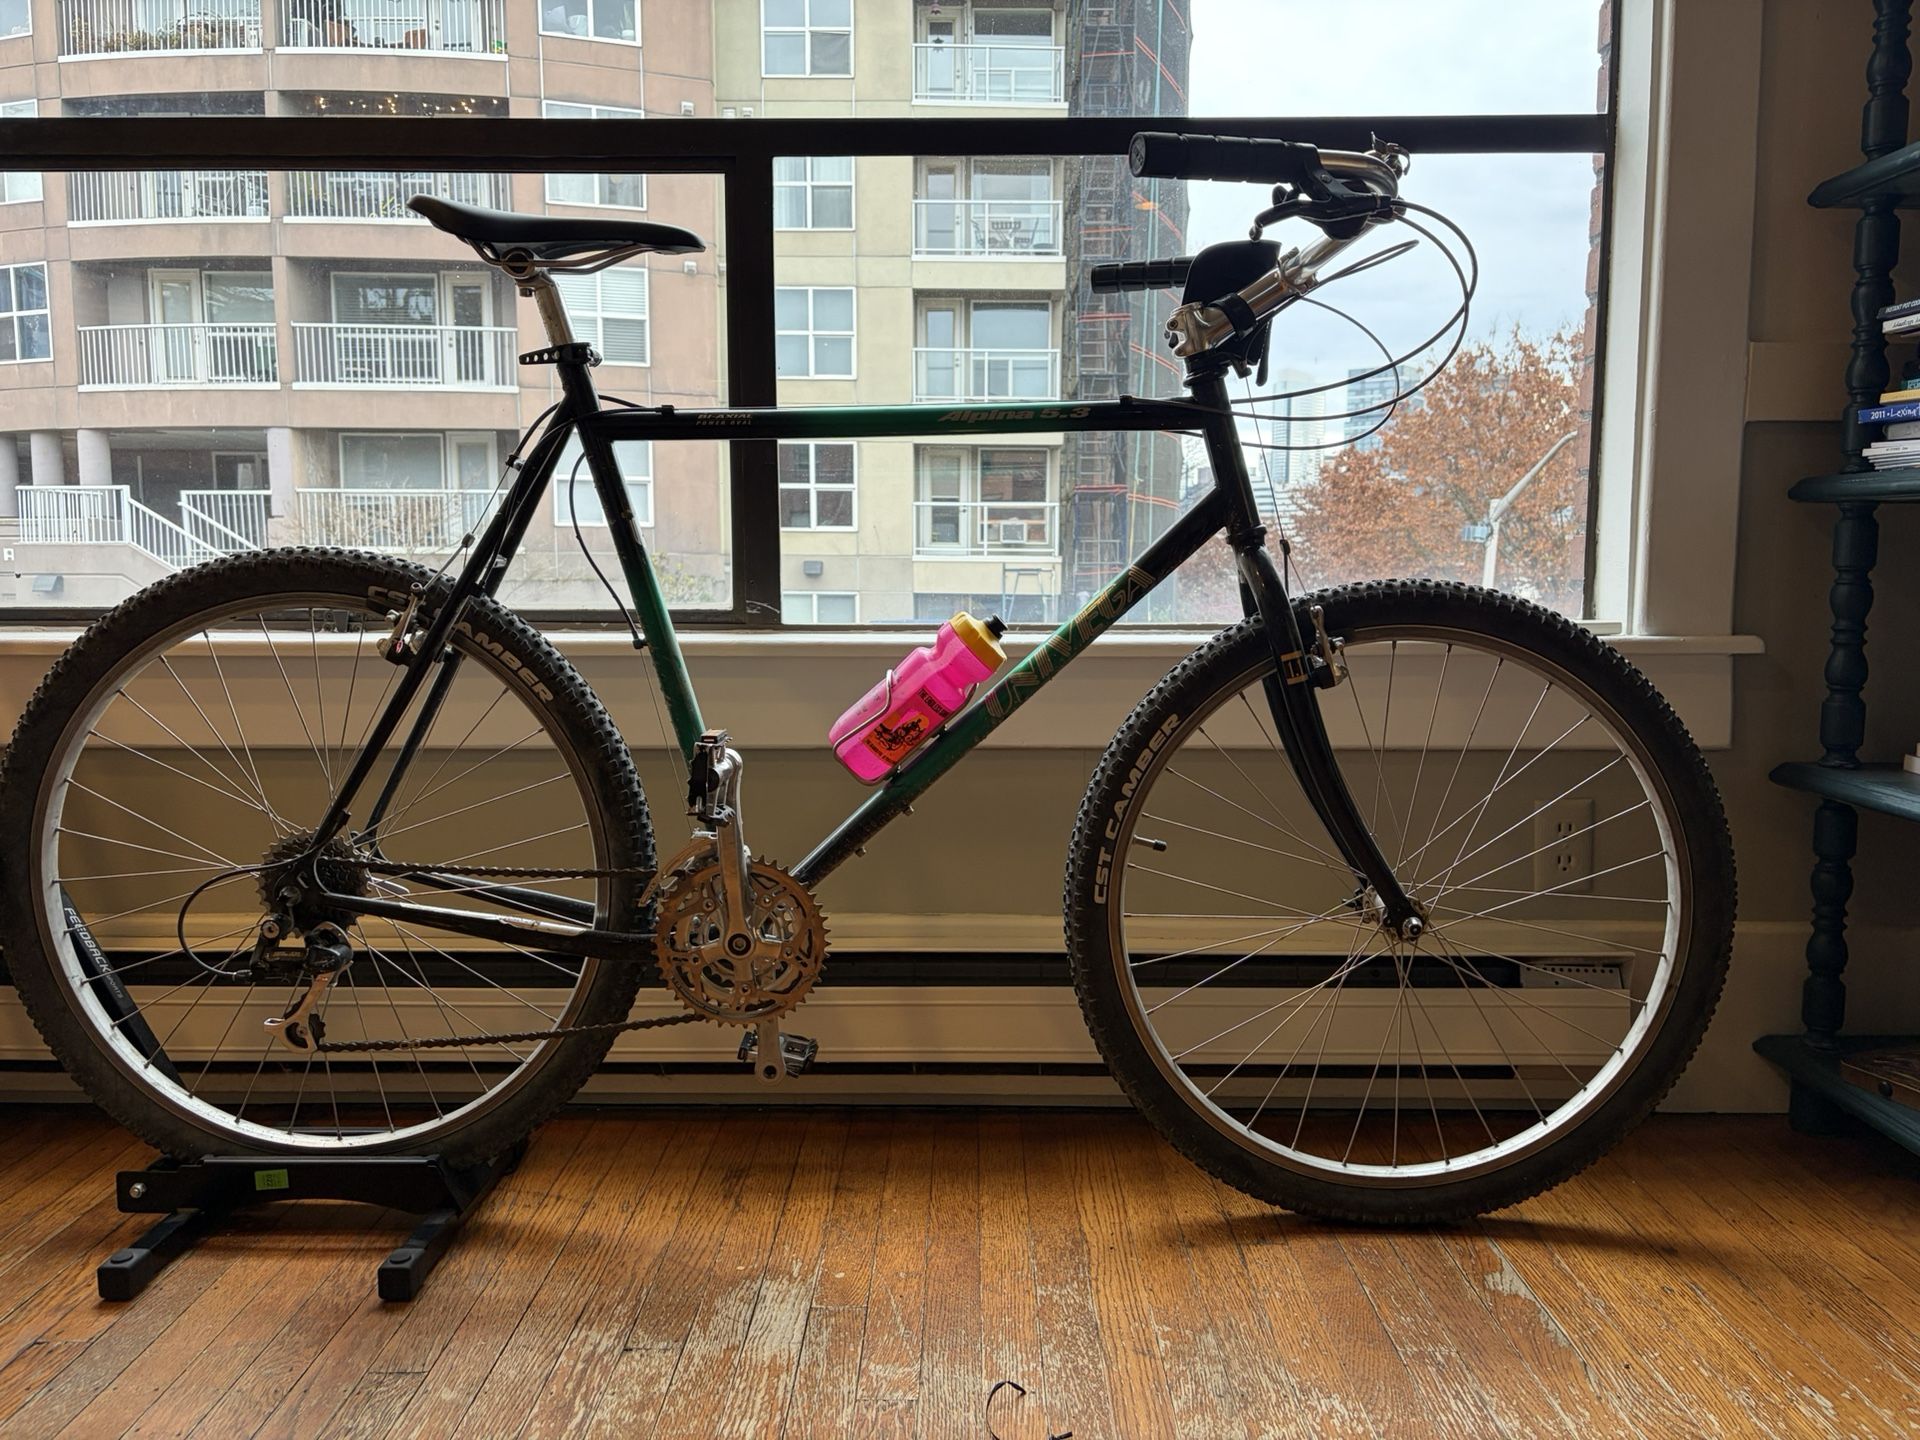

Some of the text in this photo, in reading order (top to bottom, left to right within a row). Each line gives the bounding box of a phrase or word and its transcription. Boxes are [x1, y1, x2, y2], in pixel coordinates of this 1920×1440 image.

[938, 406, 1091, 424] Alpina 5.3
[1870, 410, 1886, 420] 2011
[367, 585, 554, 702] CS AMBER
[984, 564, 1156, 718] UNIVEGA
[1094, 713, 1181, 905] CST CAMBER
[64, 907, 112, 976] FEEDBACK
